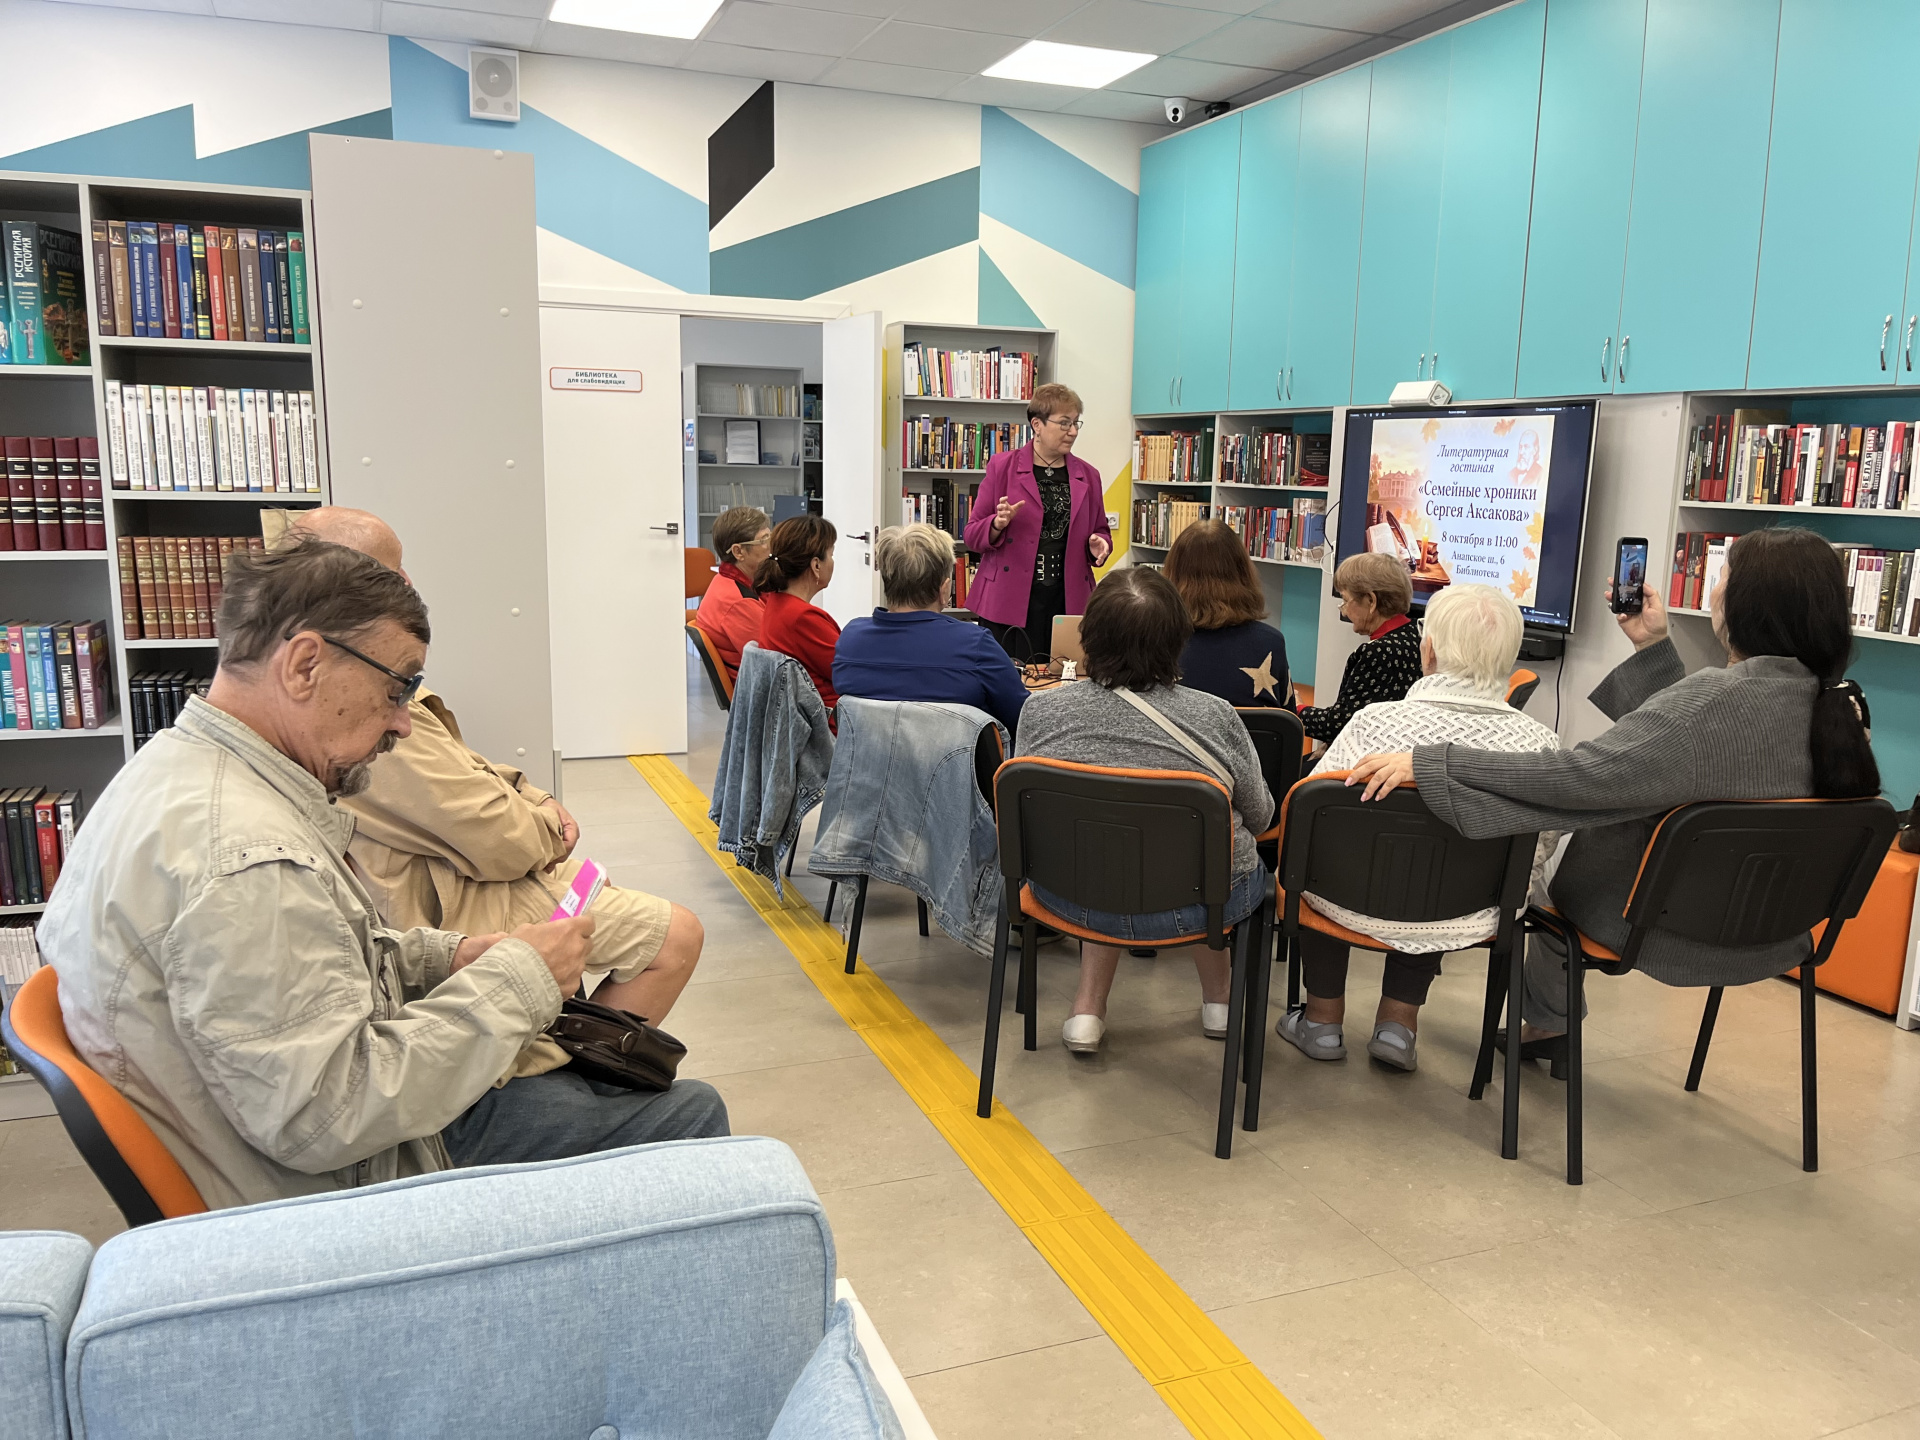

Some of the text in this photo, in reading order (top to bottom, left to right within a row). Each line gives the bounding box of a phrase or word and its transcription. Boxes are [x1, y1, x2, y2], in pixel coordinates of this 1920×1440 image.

[12, 230, 23, 278] ВСЕМИРНАЯ
[23, 237, 33, 272] ИСТОРИЯ
[1437, 445, 1509, 461] Литературная
[1862, 429, 1876, 489] БЕЛАЯ СИБИРЬ
[1449, 463, 1494, 473] гостиная
[1419, 480, 1537, 503] «Семейные хроники
[1426, 500, 1529, 521] Сергея Аксакова»
[1442, 531, 1518, 548] 8 октября в 11:00
[1451, 550, 1486, 563] Анапское
[1500, 555, 1505, 564] 6
[1456, 565, 1499, 578] Библиотека
[61, 665, 77, 716] ДЖЕРАЛЬД ДАРРЕЛЛ
[80, 668, 96, 719] ДЖЕРАЛЬД ДАРРЕЛЛ
[17, 703, 28, 719] ГЕОРГ
